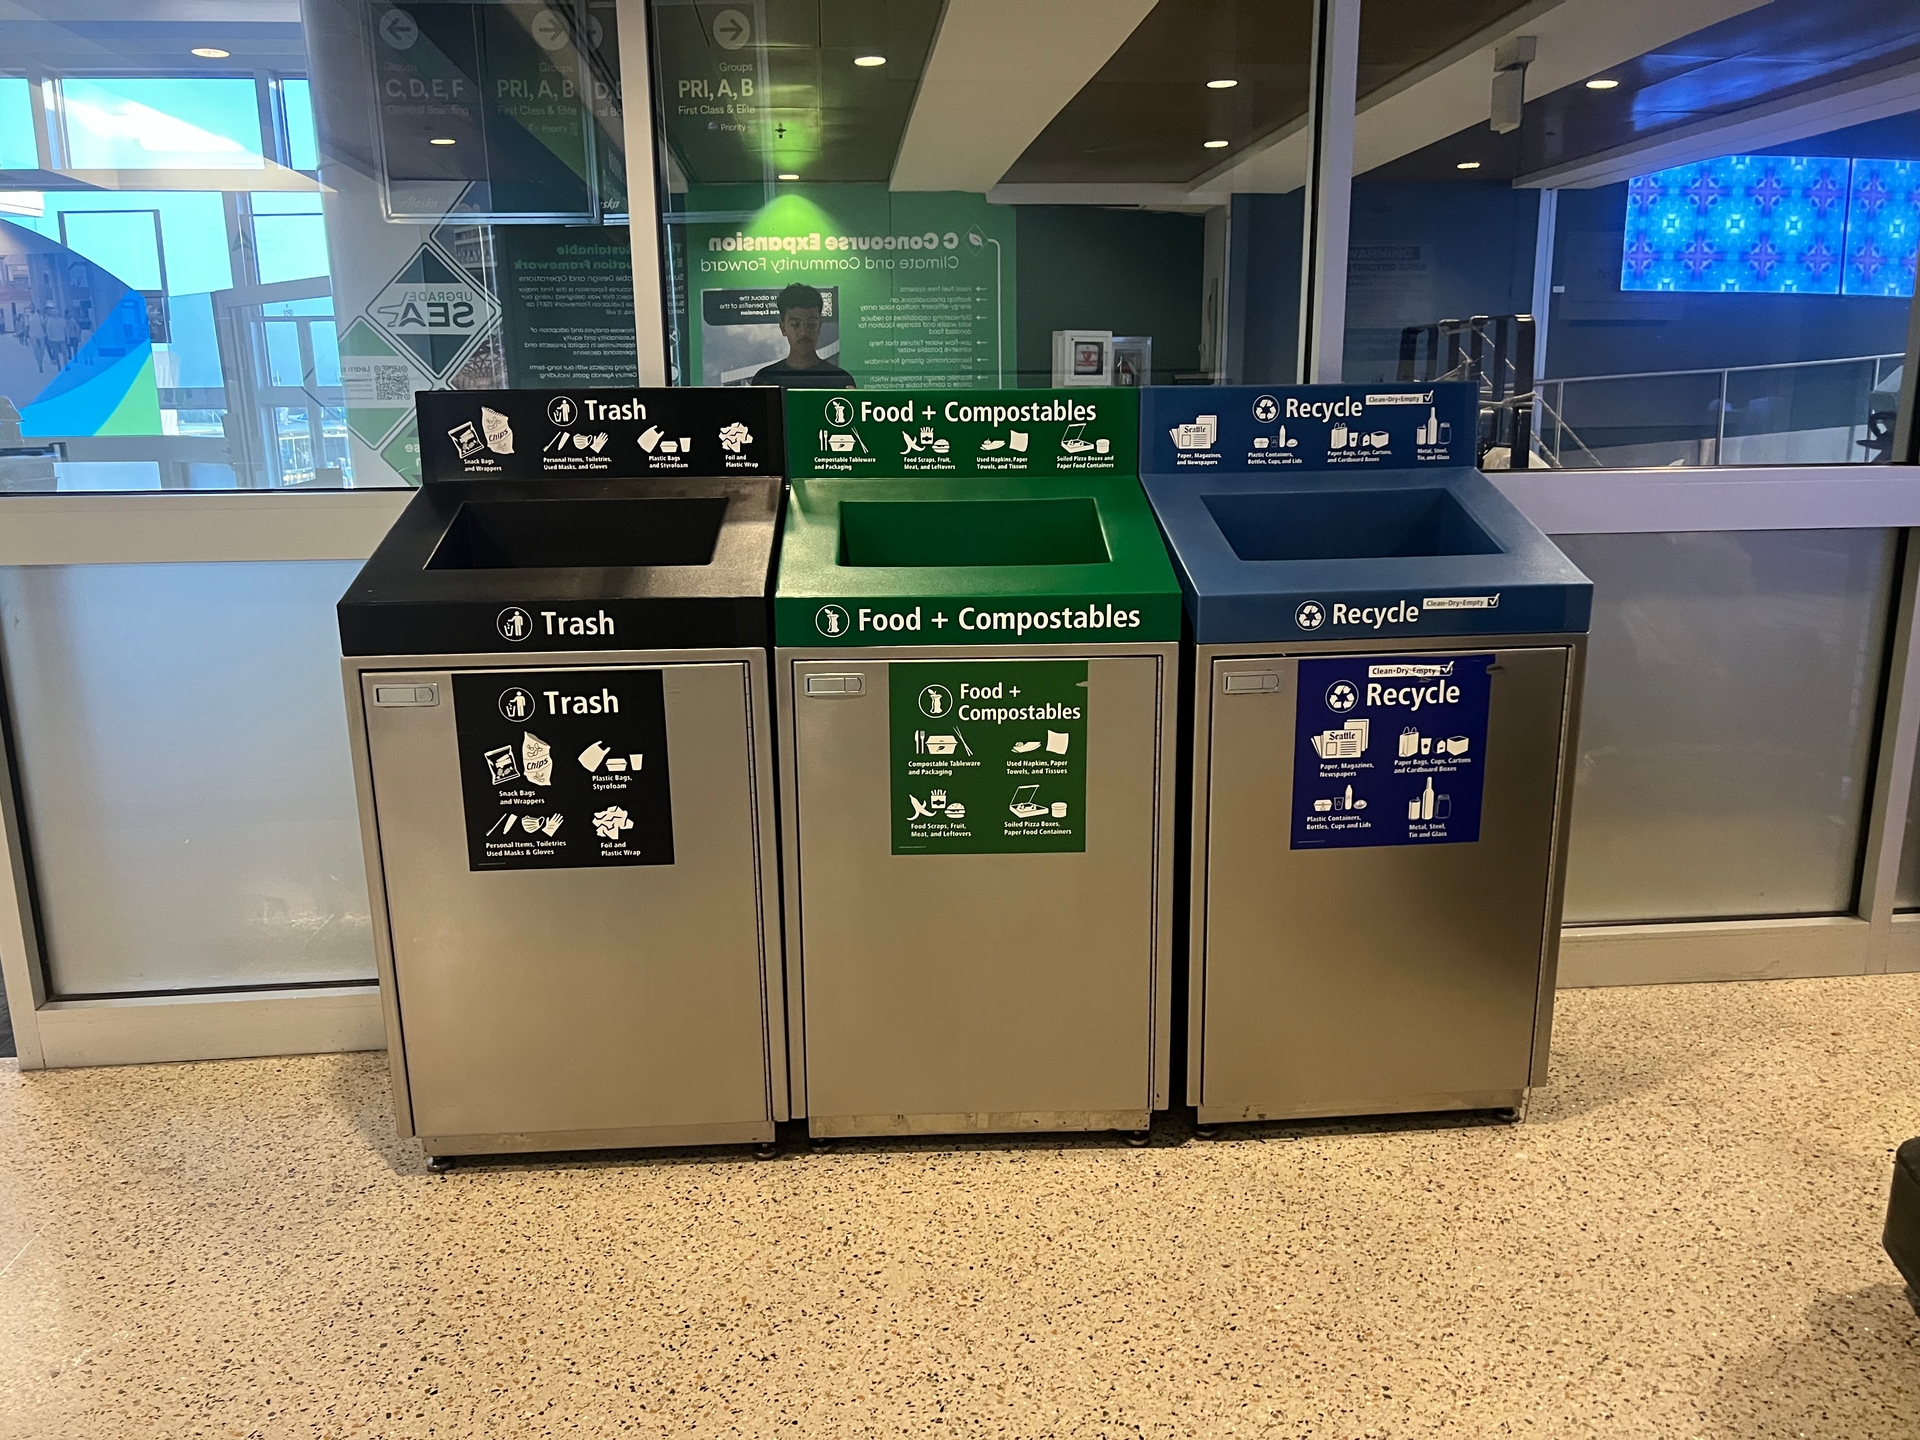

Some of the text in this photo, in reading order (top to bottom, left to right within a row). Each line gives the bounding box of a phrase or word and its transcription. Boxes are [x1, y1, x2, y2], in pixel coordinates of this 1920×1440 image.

[720, 62, 752, 73] Groups
[563, 80, 575, 97] B
[679, 78, 754, 101] PRI, A, B
[679, 104, 755, 115] First Class & Elite
[720, 123, 746, 132] Priority
[584, 397, 646, 421] Trash
[861, 399, 1096, 428] Food + Compostables
[1286, 396, 1363, 423] Recycle
[488, 428, 508, 442] Chips
[1184, 424, 1206, 435] Seattle
[814, 456, 848, 464] Compostable
[917, 456, 937, 464] Scraps,
[859, 603, 1140, 636] Food + Compostables
[1333, 600, 1419, 629] Recycle
[540, 610, 615, 635] Trash
[960, 682, 1021, 699] Food +
[1366, 679, 1460, 711] Recycle
[543, 688, 619, 715] Trash
[958, 702, 1081, 725] Compostables
[1329, 731, 1356, 741] Seattle
[526, 757, 549, 771] Chips
[908, 760, 949, 768] Compostable
[1023, 760, 1050, 768] Napkins,
[1320, 763, 1340, 771] Paper,
[1394, 759, 1412, 767] Paper
[614, 774, 633, 782] Bags,
[921, 768, 953, 777] Packaging
[592, 782, 627, 791] Styrofoam
[519, 790, 536, 798] Bags
[1004, 829, 1022, 837] Paper
[485, 841, 514, 849] Personal
